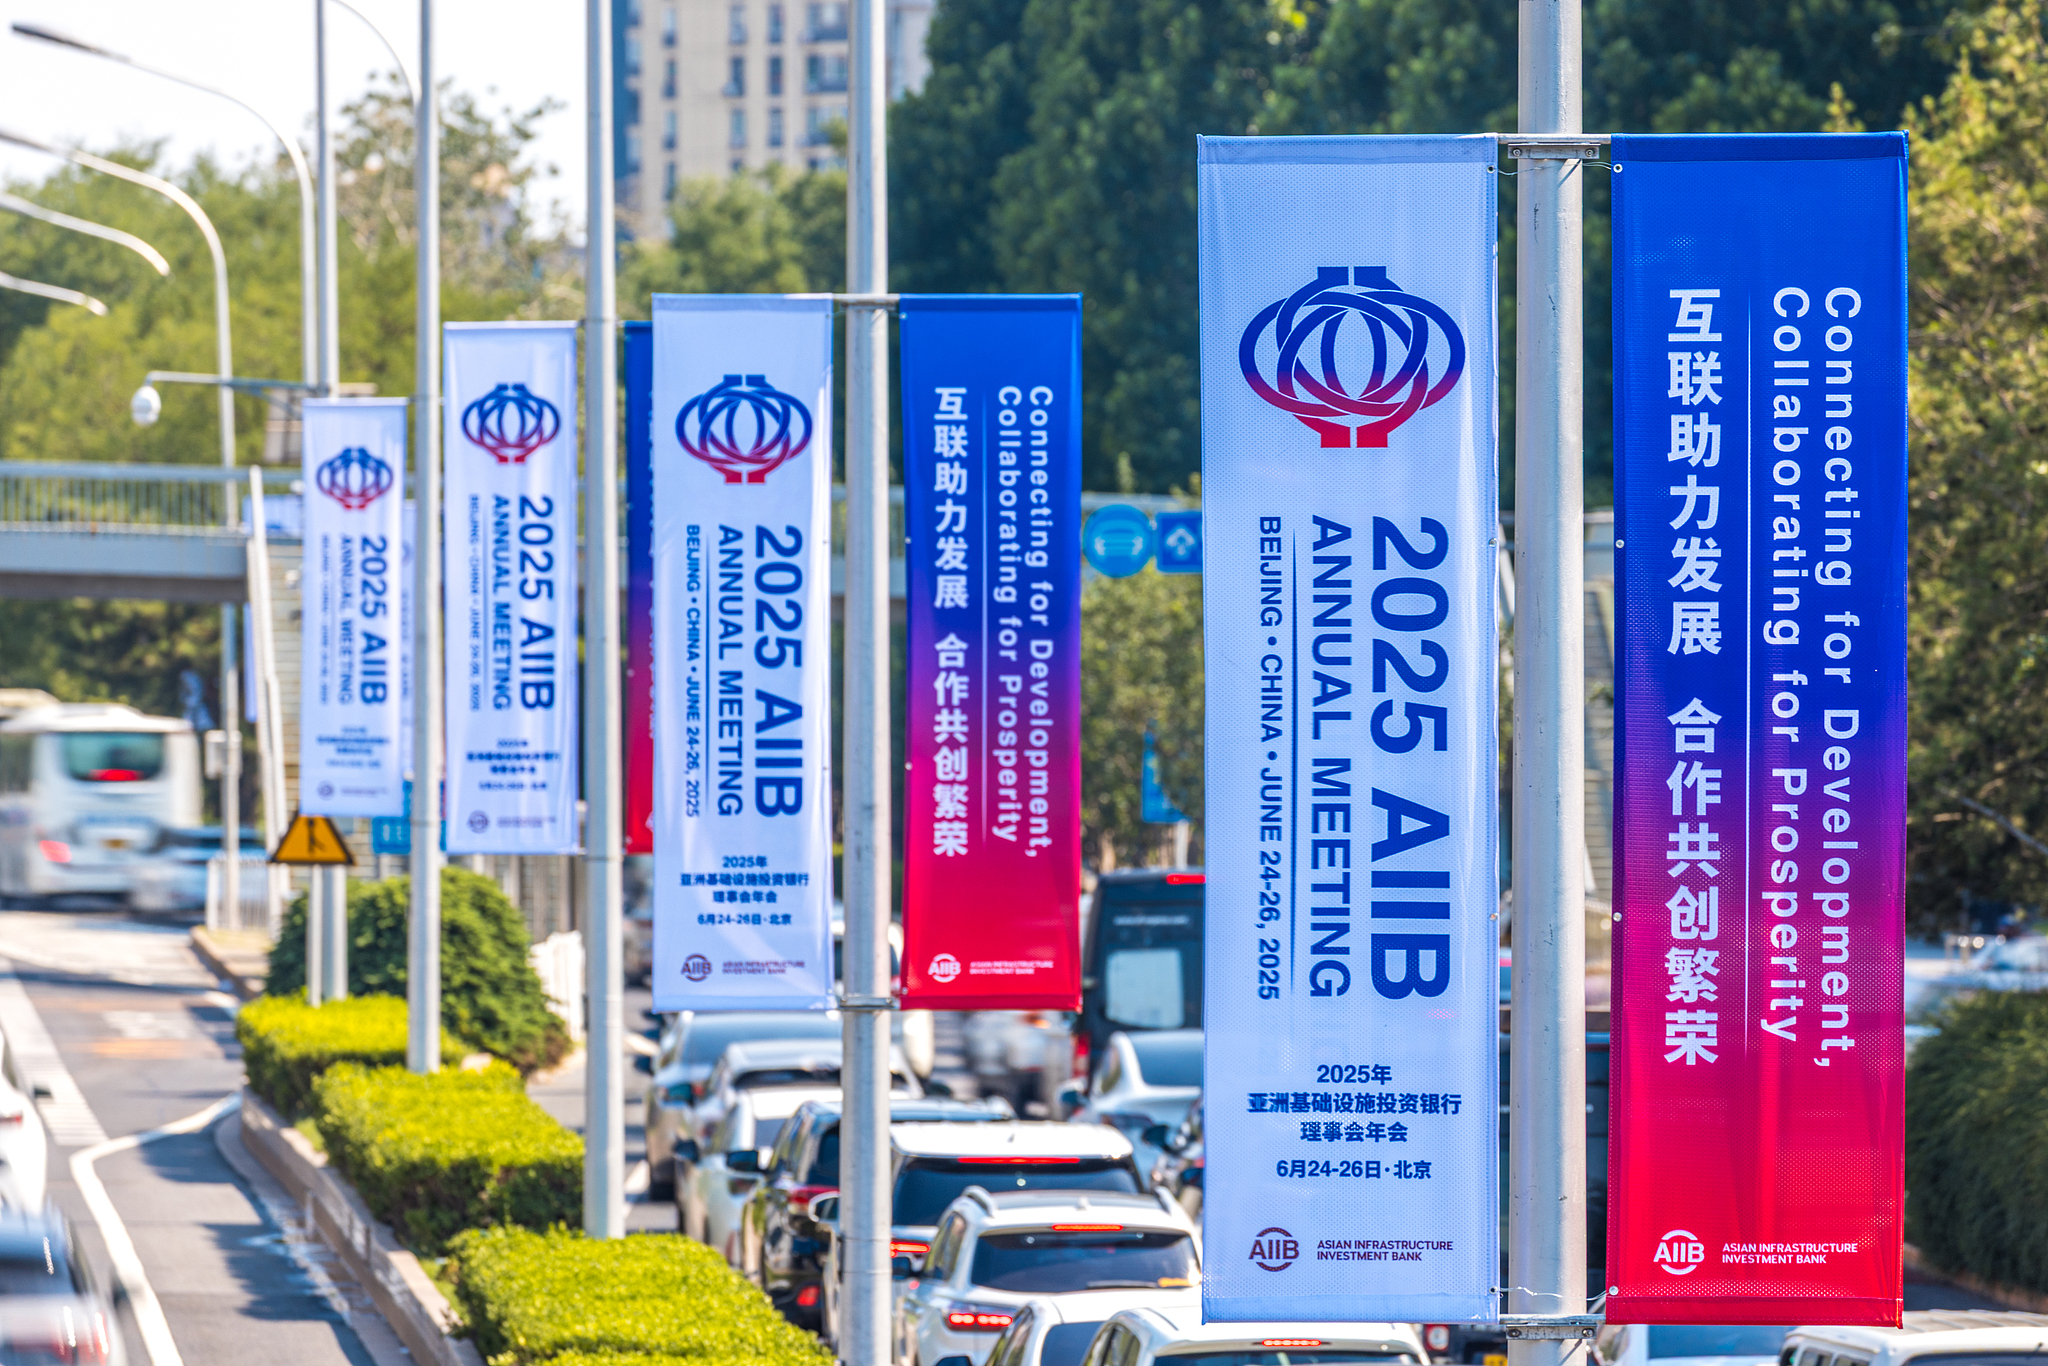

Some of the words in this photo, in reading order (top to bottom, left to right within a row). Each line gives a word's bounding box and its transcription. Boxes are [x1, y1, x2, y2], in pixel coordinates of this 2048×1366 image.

[1025, 386, 1053, 567] Connecting
[1667, 289, 1722, 655] 互联助力发展
[1763, 287, 1810, 644] Collaborating
[1815, 287, 1861, 585] Connecting
[934, 388, 968, 608] 互联助力发展
[994, 386, 1022, 602] Collaborating
[361, 536, 387, 618] 2025
[493, 495, 510, 593] ANNUAL
[519, 496, 553, 599] 2025
[687, 525, 700, 592] BEIJING
[1260, 517, 1282, 626] BEIJING
[687, 608, 700, 661] CHINA
[719, 525, 743, 660] ANNUAL
[755, 526, 802, 669] 2025
[1030, 581, 1053, 626] for
[1312, 515, 1352, 740] ANNUAL
[1370, 516, 1449, 753] 2025
[360, 631, 387, 704] AIIB
[493, 603, 511, 709] MEETING
[521, 618, 554, 709] AIIB
[999, 617, 1022, 661] for
[1824, 611, 1860, 683] for
[687, 676, 700, 721] JUNE
[1261, 654, 1282, 742] CHINA
[1772, 670, 1808, 742] for
[718, 671, 743, 815] MEETING
[755, 689, 802, 817] AIIB
[933, 633, 969, 856] 合作共创繁荣
[992, 675, 1022, 841] Prosperity
[1024, 640, 1054, 857] Development,
[686, 780, 699, 817] 2025
[1260, 768, 1282, 842] JUNE
[723, 856, 767, 868] 2025年
[1256, 851, 1281, 928] 24-26,
[1309, 758, 1351, 996] MEETING
[1371, 787, 1450, 999] AIIB
[1664, 697, 1722, 1065] 合作共创繁荣
[1761, 768, 1807, 1041] Prosperity
[1813, 709, 1859, 1067] Development,
[682, 961, 711, 975] AIIB
[928, 961, 961, 976] AIIB
[1258, 939, 1280, 999] 2025
[1248, 1092, 1461, 1114] 亚洲基础设施投资银行
[1317, 1064, 1392, 1085] 2025年
[1300, 1121, 1408, 1142] 理事会年会
[1249, 1240, 1299, 1259] AIIB
[1318, 1240, 1351, 1249] ASIAN
[1355, 1240, 1453, 1250] INFRASTRUCTURE
[1318, 1251, 1389, 1260] INVESTMENT
[1392, 1252, 1421, 1261] BANK
[1654, 1242, 1704, 1262] AIIB
[1723, 1243, 1756, 1252] ASIAN
[1759, 1243, 1858, 1252] INFRASTRUCTURE
[1723, 1254, 1793, 1263] INVESTMENT
[1797, 1255, 1826, 1263] BANK
